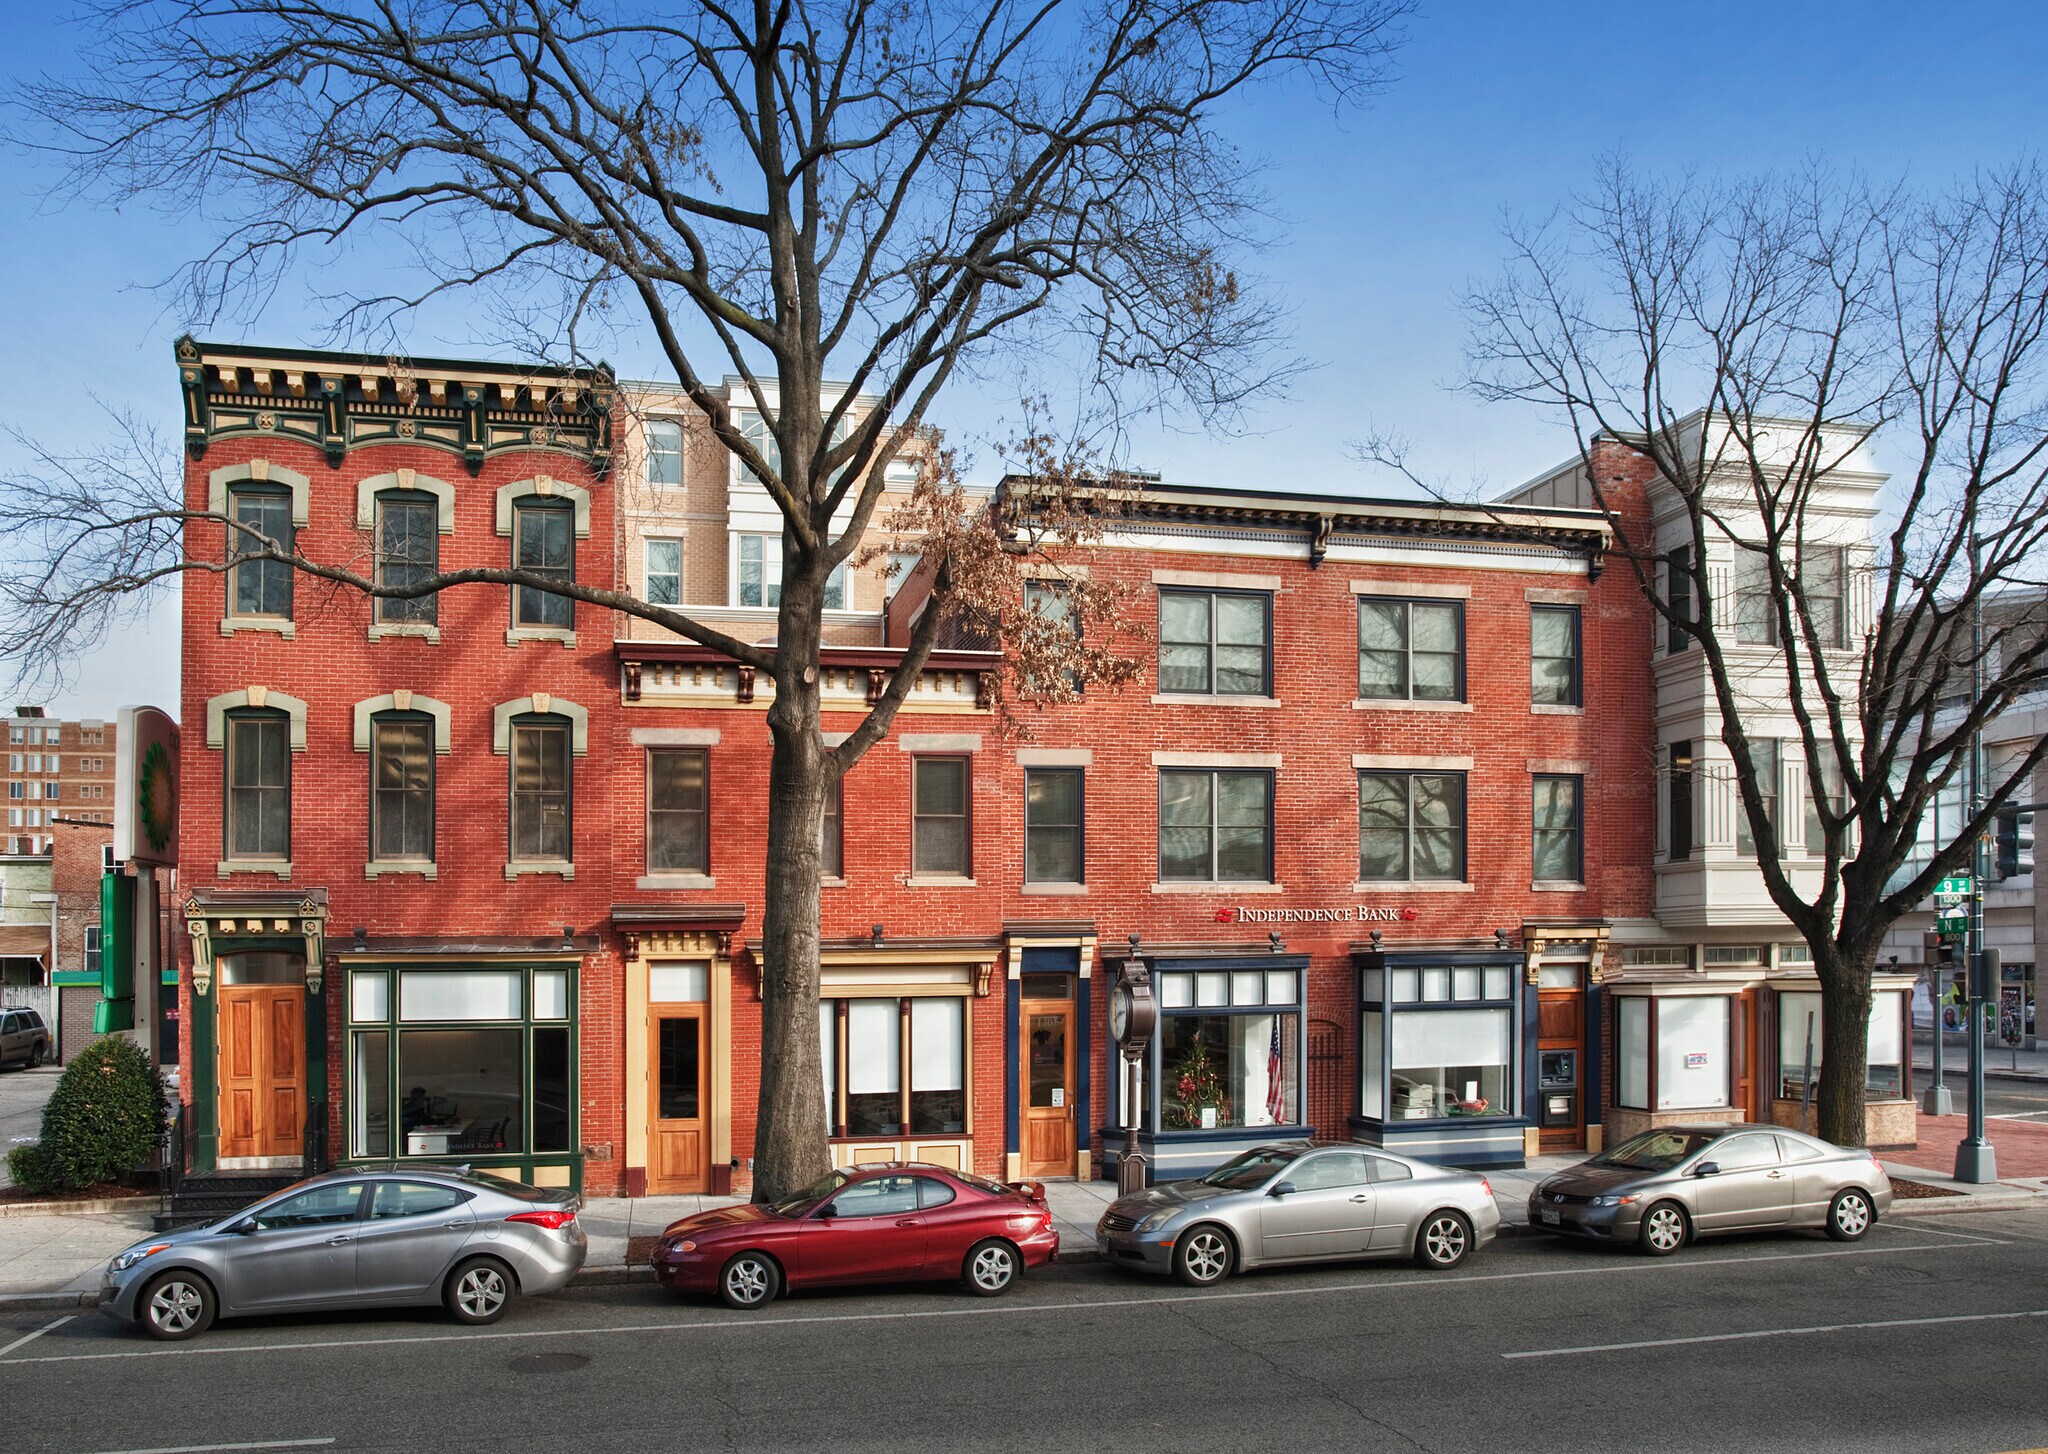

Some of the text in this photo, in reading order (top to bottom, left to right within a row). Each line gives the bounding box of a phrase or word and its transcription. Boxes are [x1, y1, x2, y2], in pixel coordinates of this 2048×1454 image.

[1943, 880, 1953, 893] 9
[1943, 894, 1962, 903] 1300
[1238, 905, 1399, 923] INDEPENDENCE BANK
[1944, 919, 1952, 930] N
[1945, 933, 1961, 942] 800
